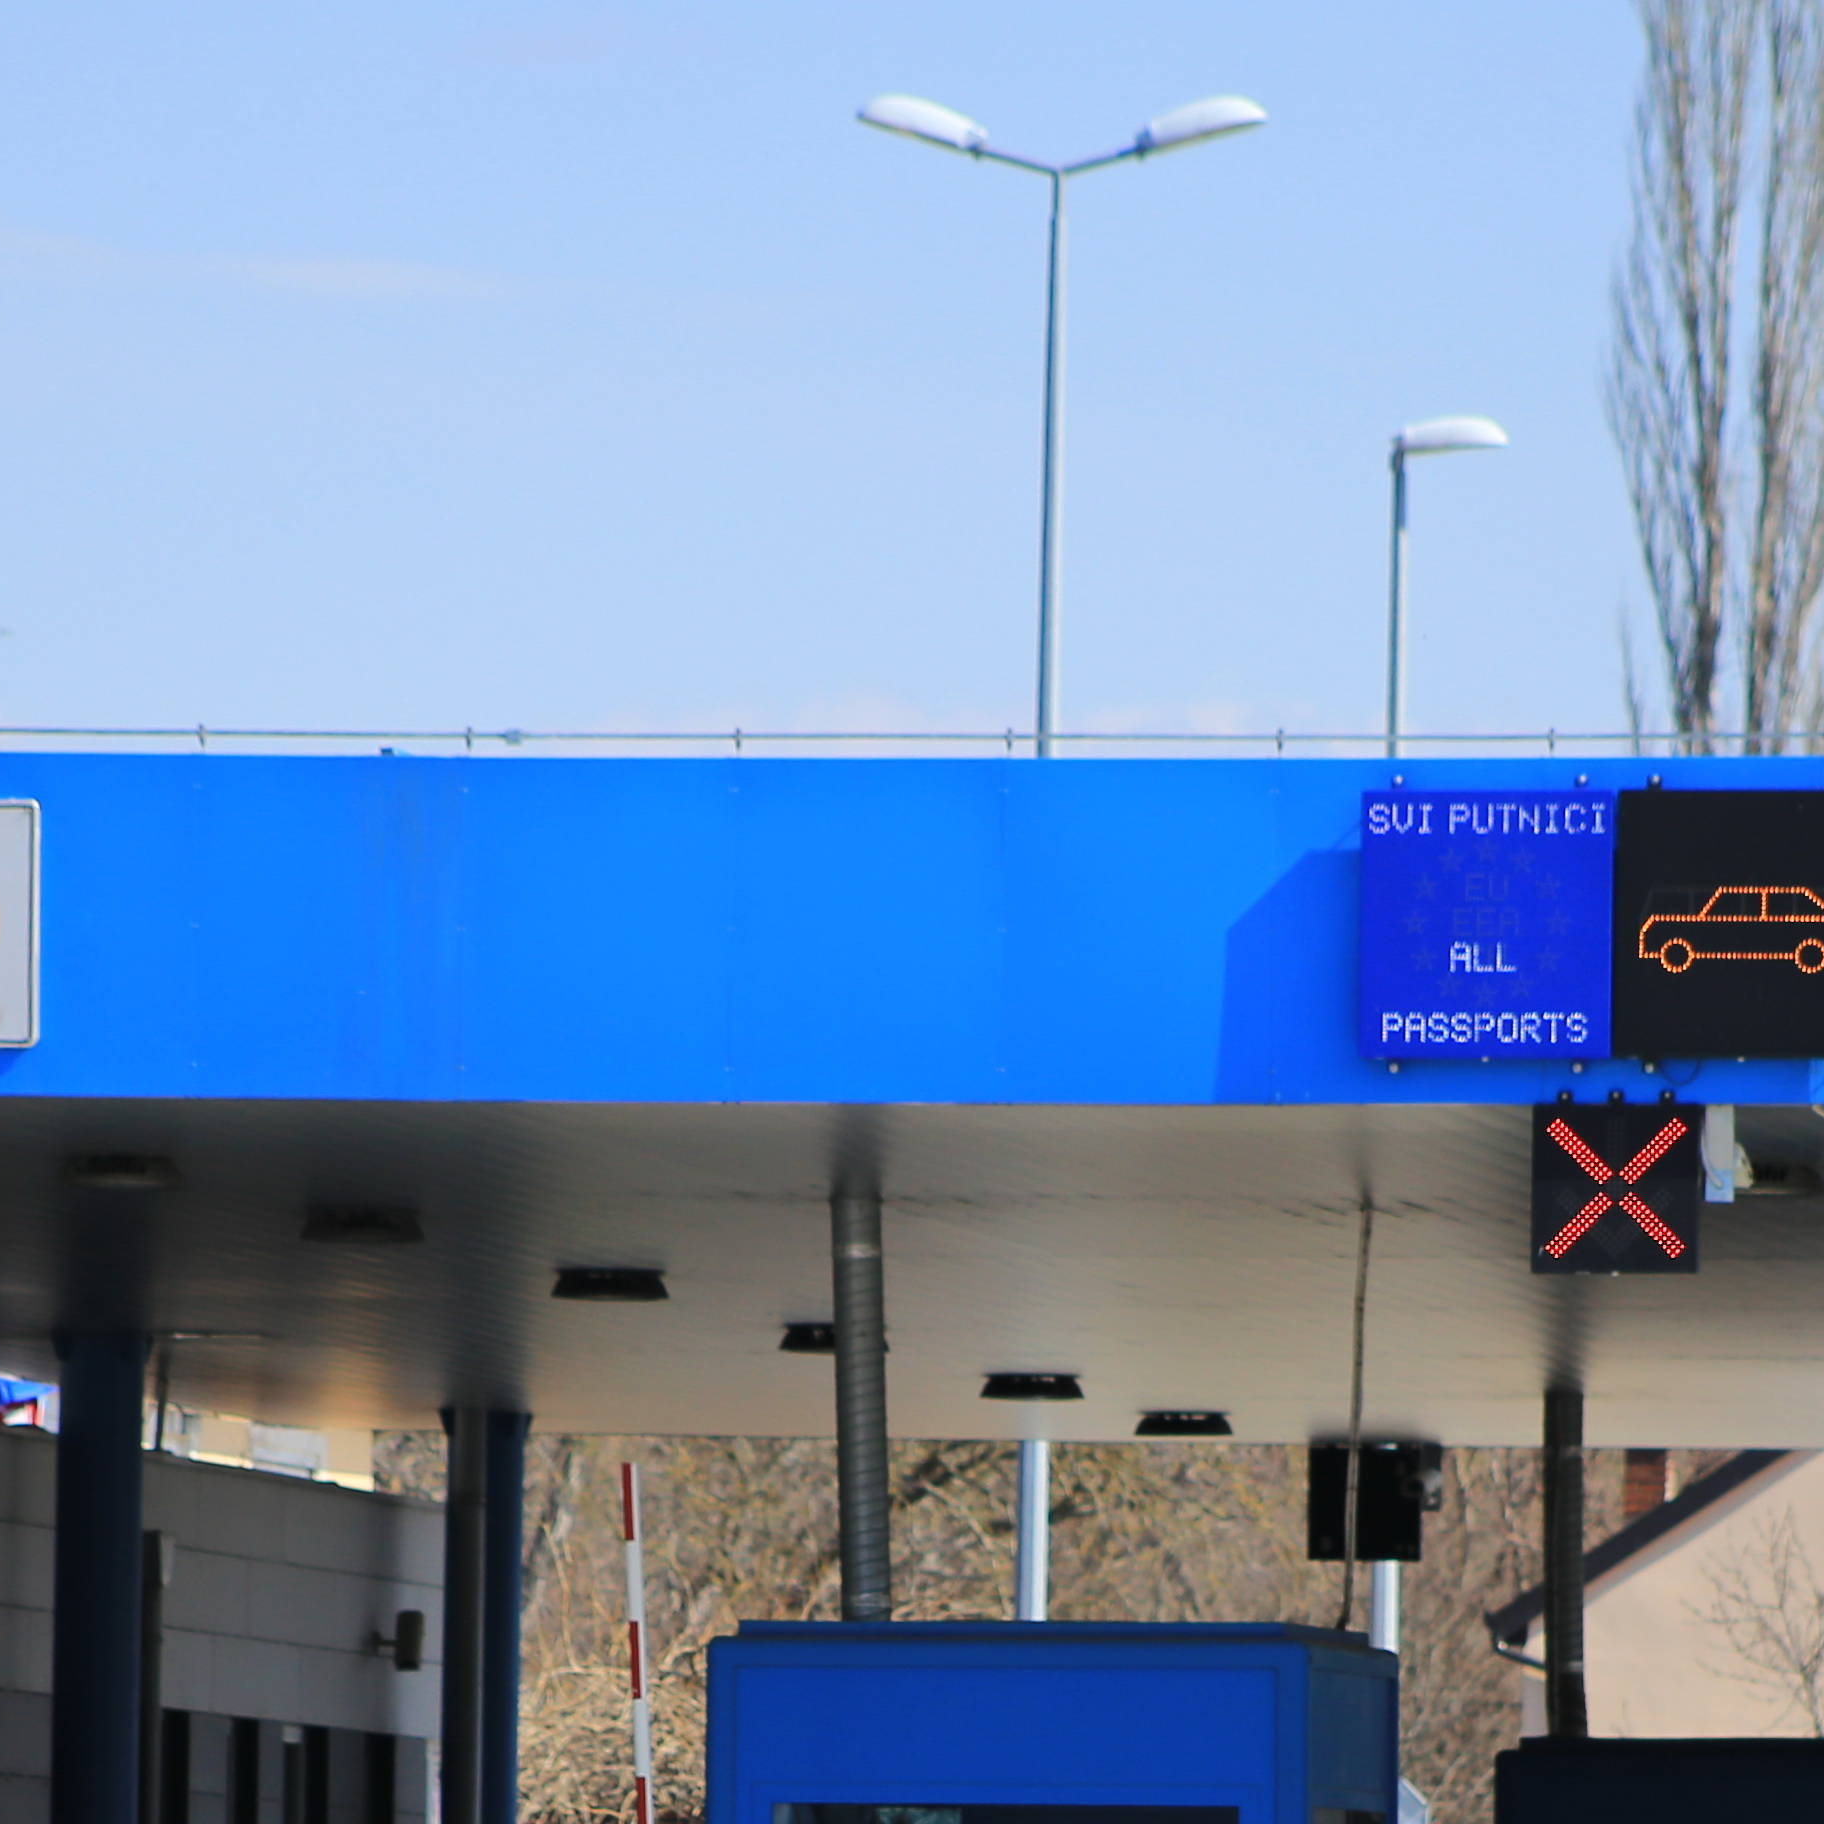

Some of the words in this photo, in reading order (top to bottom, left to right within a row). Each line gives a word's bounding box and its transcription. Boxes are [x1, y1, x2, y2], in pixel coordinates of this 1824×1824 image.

[1368, 802, 1433, 835] SVI
[1448, 802, 1606, 835] PUTNICI
[1464, 872, 1509, 902] EU
[1452, 907, 1520, 937] EEA
[1449, 940, 1518, 973] ALL
[1381, 1010, 1589, 1044] PASSPORTS
